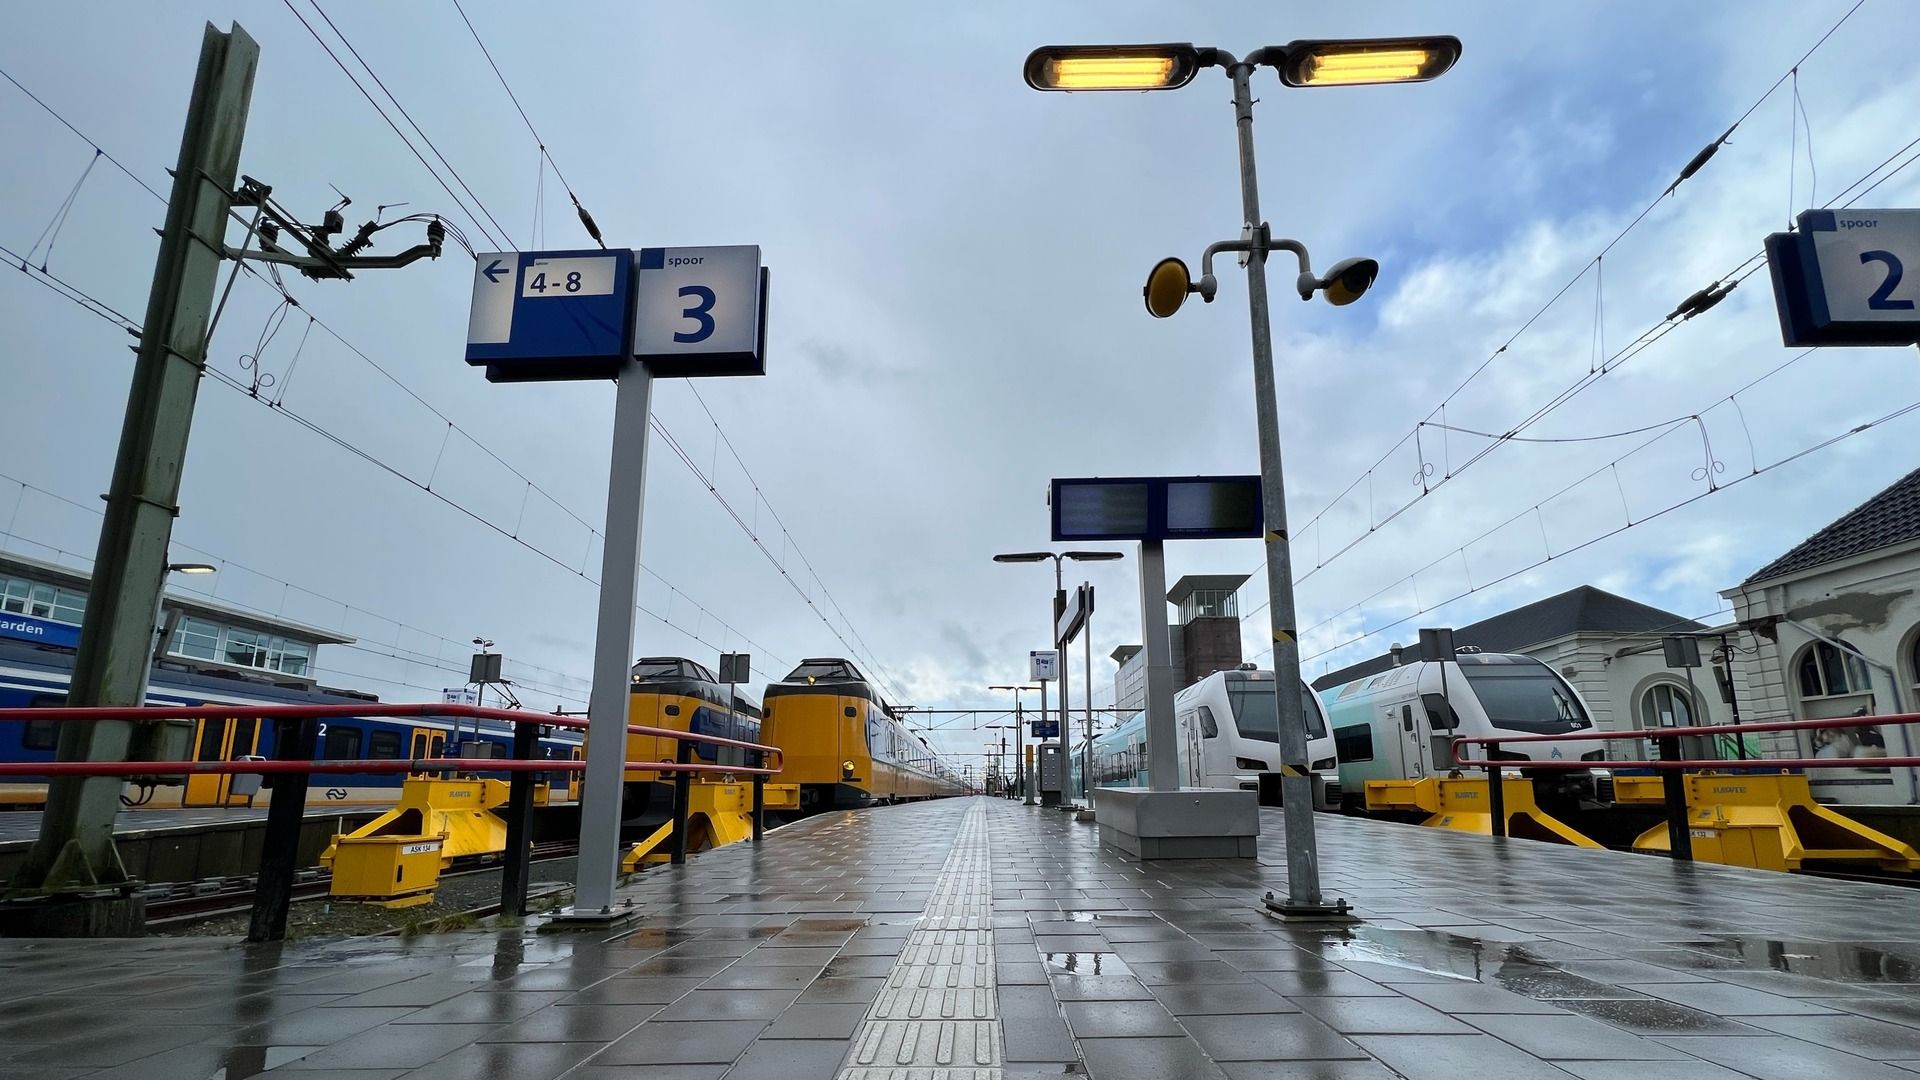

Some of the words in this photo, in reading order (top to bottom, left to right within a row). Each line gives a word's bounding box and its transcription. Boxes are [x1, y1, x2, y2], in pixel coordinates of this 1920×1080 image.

[1840, 219, 1878, 230] spoor
[667, 256, 704, 268] spoor
[1859, 250, 1915, 310] 2
[673, 285, 716, 344] 3
[0, 620, 43, 635] arden
[318, 723, 327, 737] 2
[546, 747, 552, 757] 2
[411, 845, 422, 853] ASK
